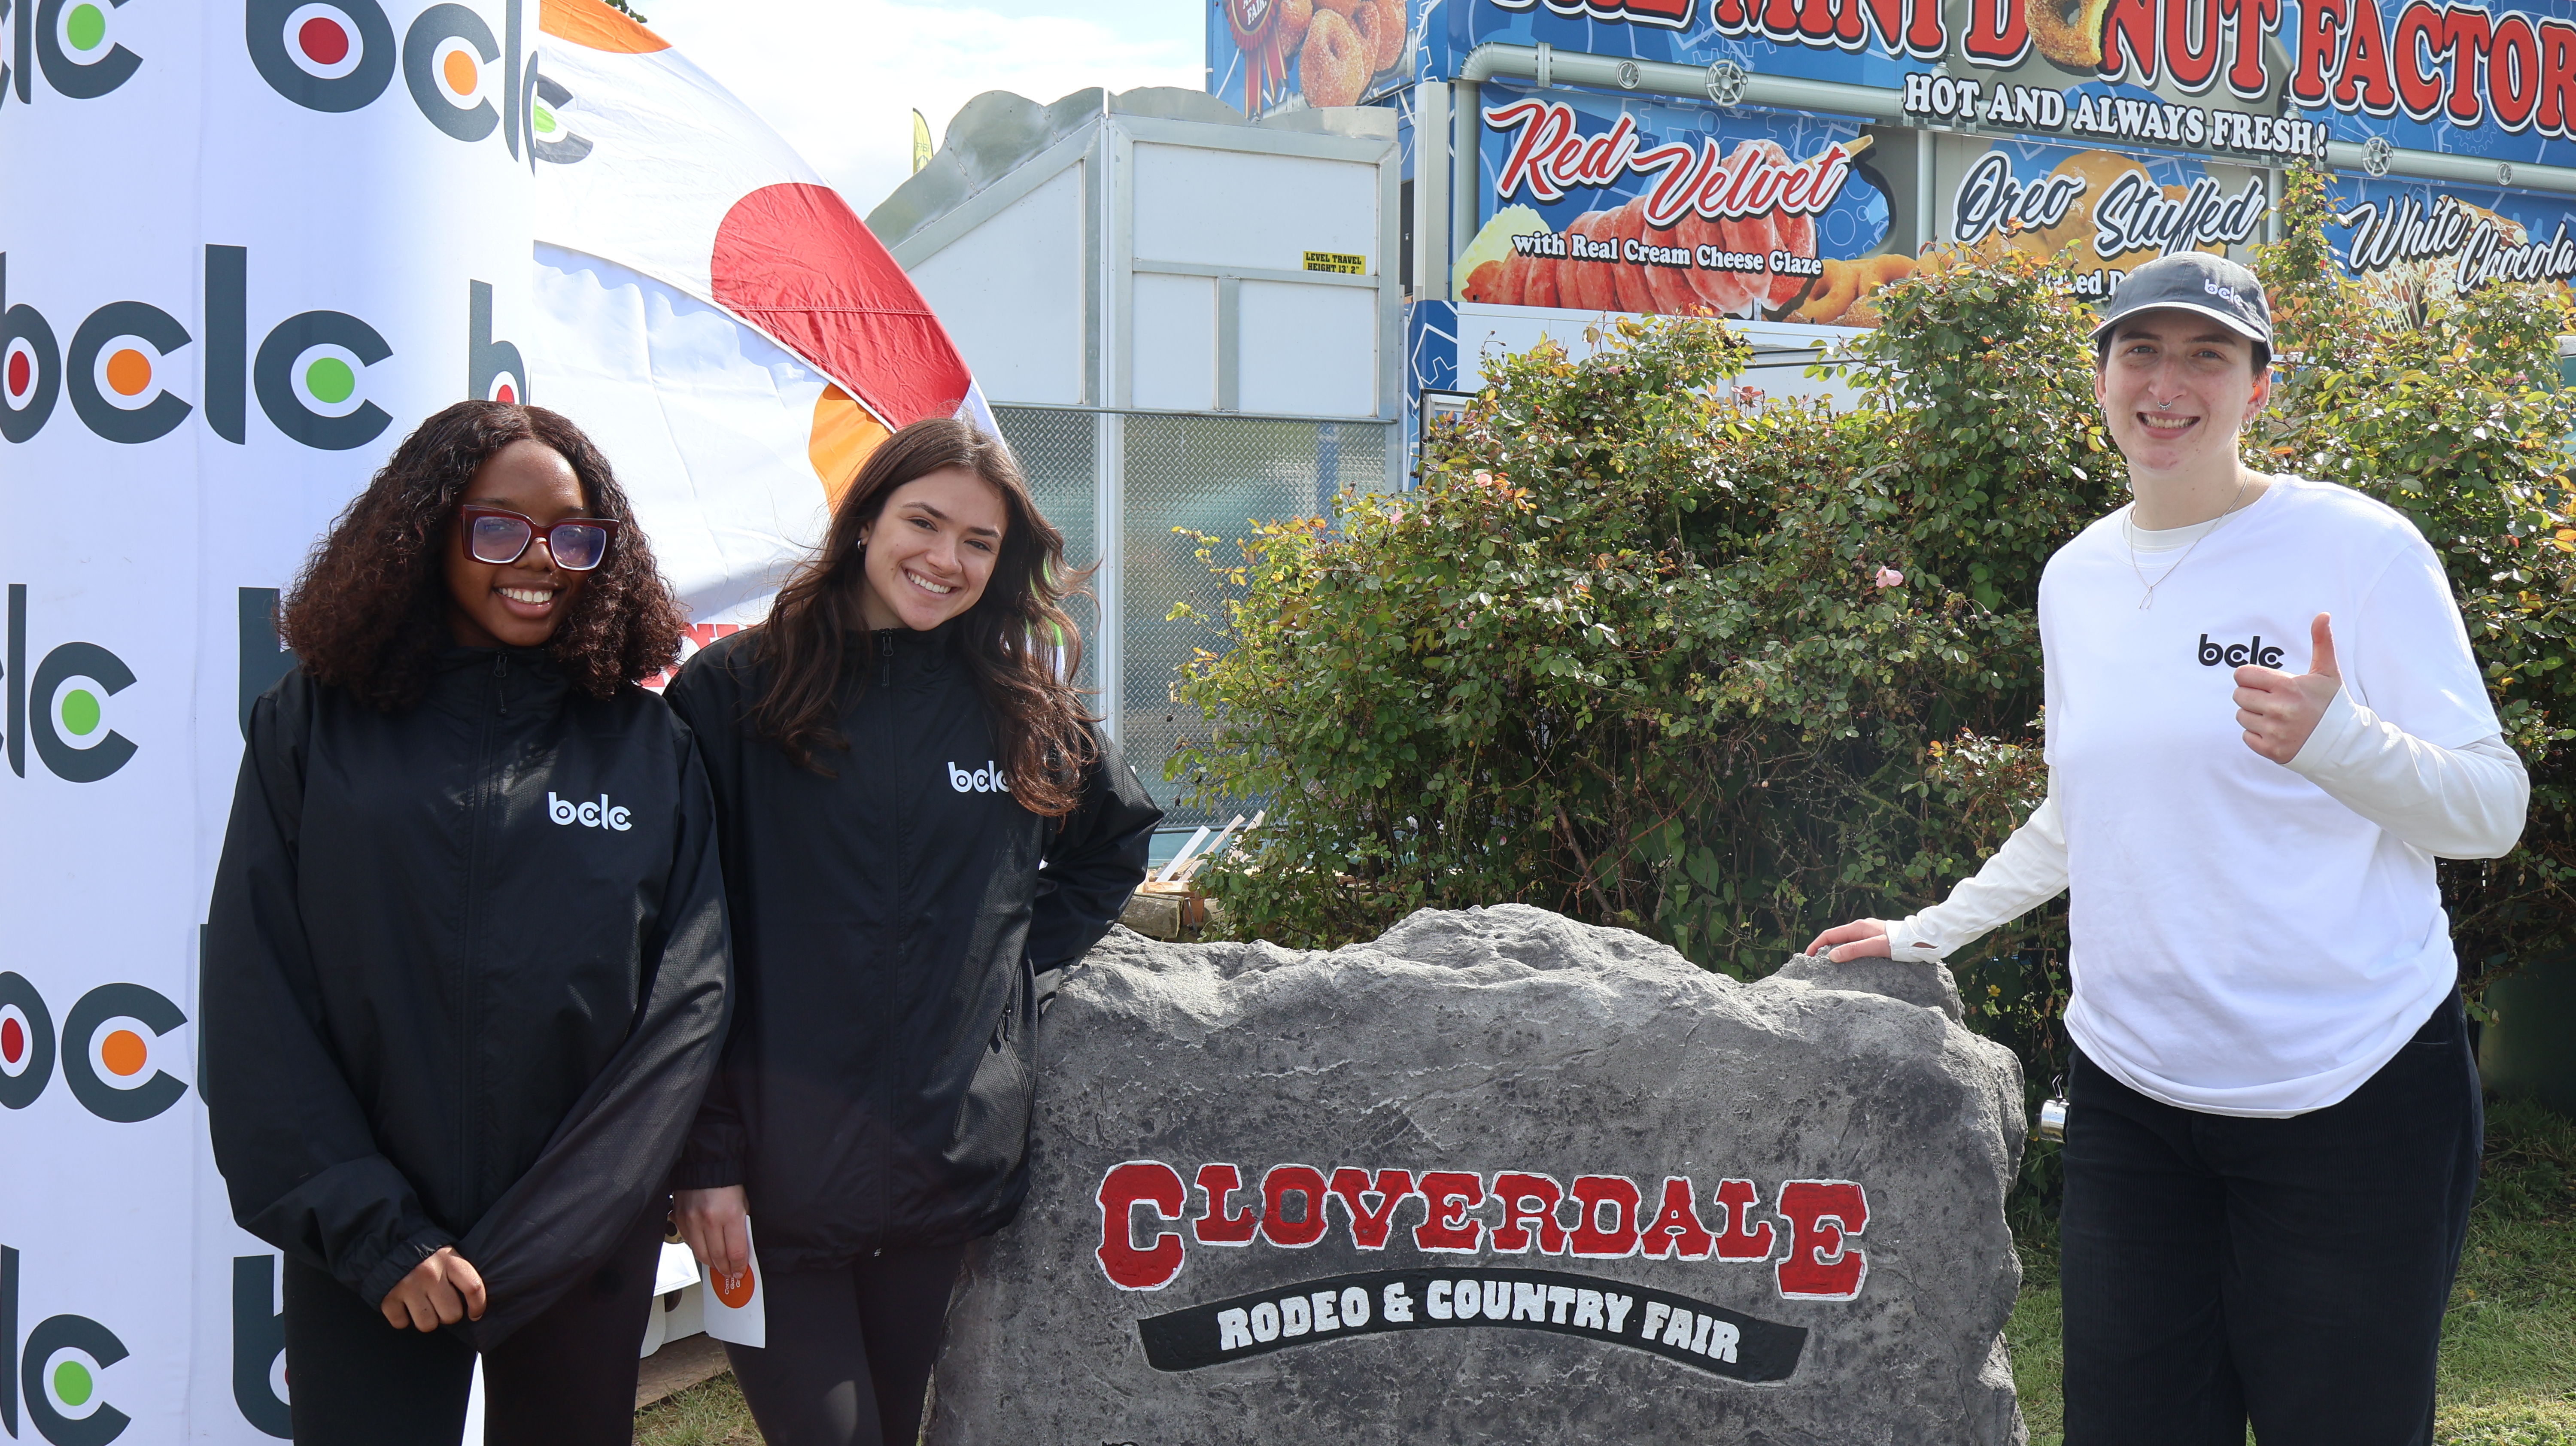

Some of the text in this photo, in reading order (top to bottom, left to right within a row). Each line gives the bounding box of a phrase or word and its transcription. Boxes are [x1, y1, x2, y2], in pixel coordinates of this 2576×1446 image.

[1905, 75, 2328, 156] HOT AND ALWAYS FRESH!
[1486, 102, 1848, 222] Red Velvet
[1955, 154, 2263, 256] Oreo Stuffed
[2343, 194, 2470, 270] White
[1306, 252, 1361, 265] LEVEL TRAVEL
[1308, 263, 1337, 273] HEIGHT
[1513, 232, 1823, 275] with Real Cream Cheese Glaze
[2204, 279, 2243, 307] bclc
[2198, 633, 2285, 670] bclc
[548, 791, 632, 831] bclc
[1094, 1160, 1870, 1300] CLOVERDALE
[1218, 1279, 1741, 1364] RODEO & COUNTRY FAIR
